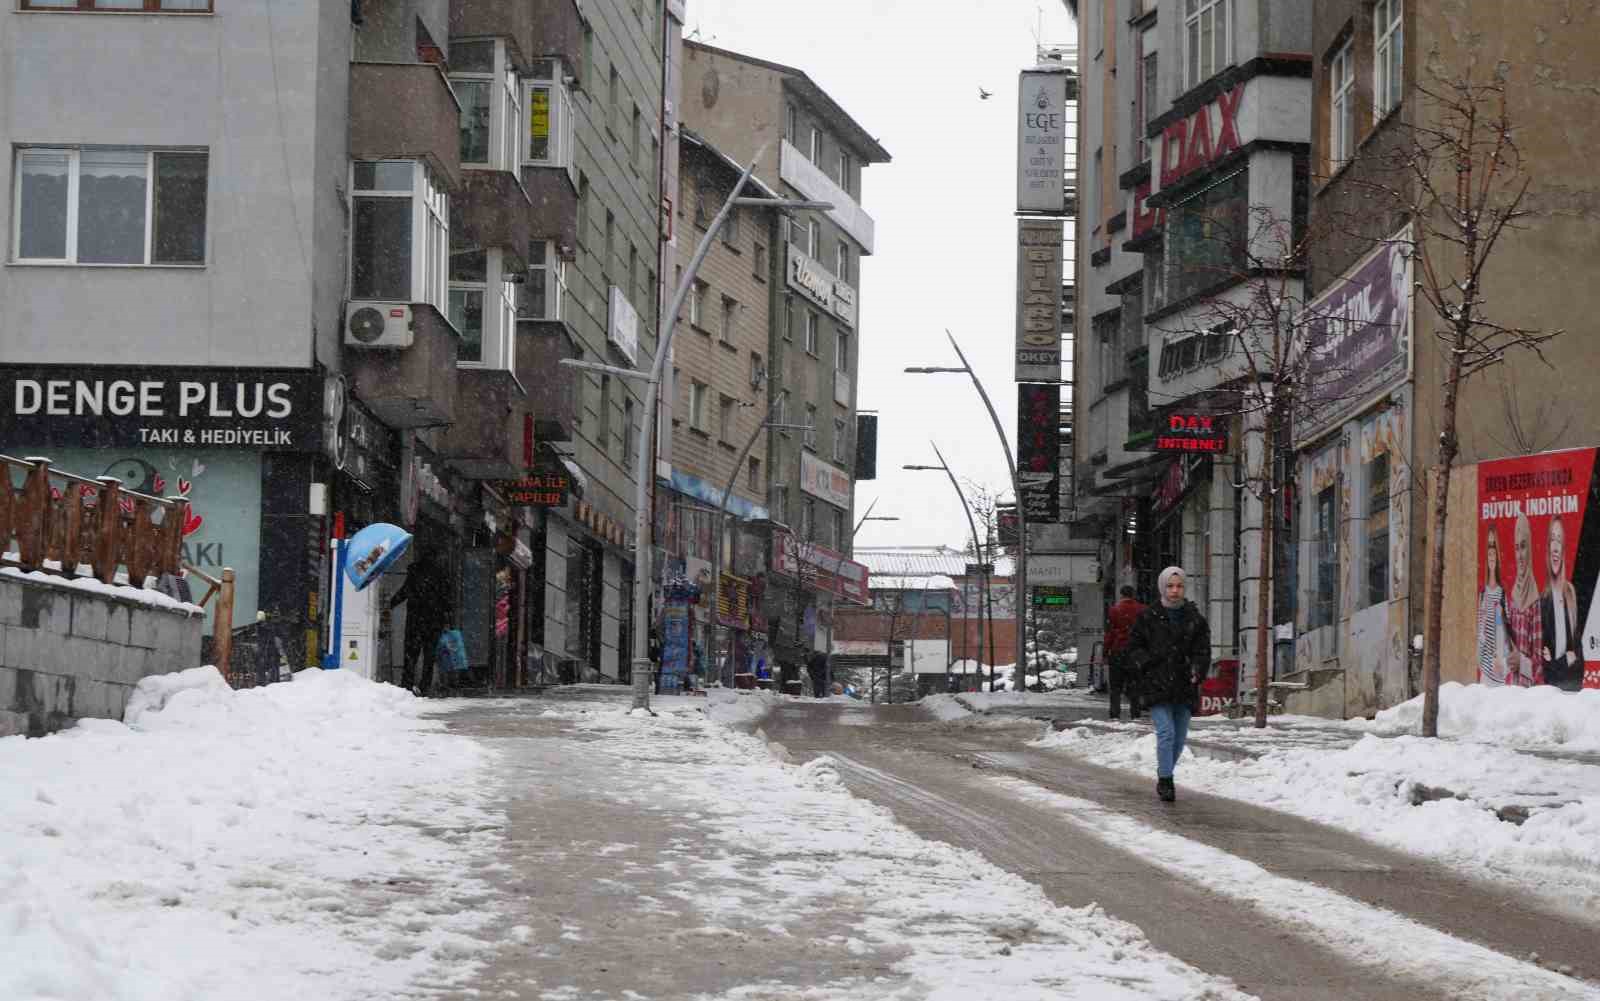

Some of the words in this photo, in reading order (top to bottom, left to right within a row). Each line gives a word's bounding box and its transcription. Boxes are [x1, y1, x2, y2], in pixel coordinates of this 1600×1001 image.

[1026, 112, 1060, 132] EGE
[1160, 80, 1246, 186] DAX
[15, 379, 165, 416] DENGE
[179, 381, 292, 418] PLUS
[1170, 415, 1214, 432] DAX
[139, 428, 178, 443] TAKI
[183, 428, 196, 443] &
[201, 426, 291, 445] HEDİYELİK
[1482, 495, 1521, 520] BÜYÜK
[1526, 489, 1579, 516] İNDİRİM
[1200, 695, 1234, 712] DAX
